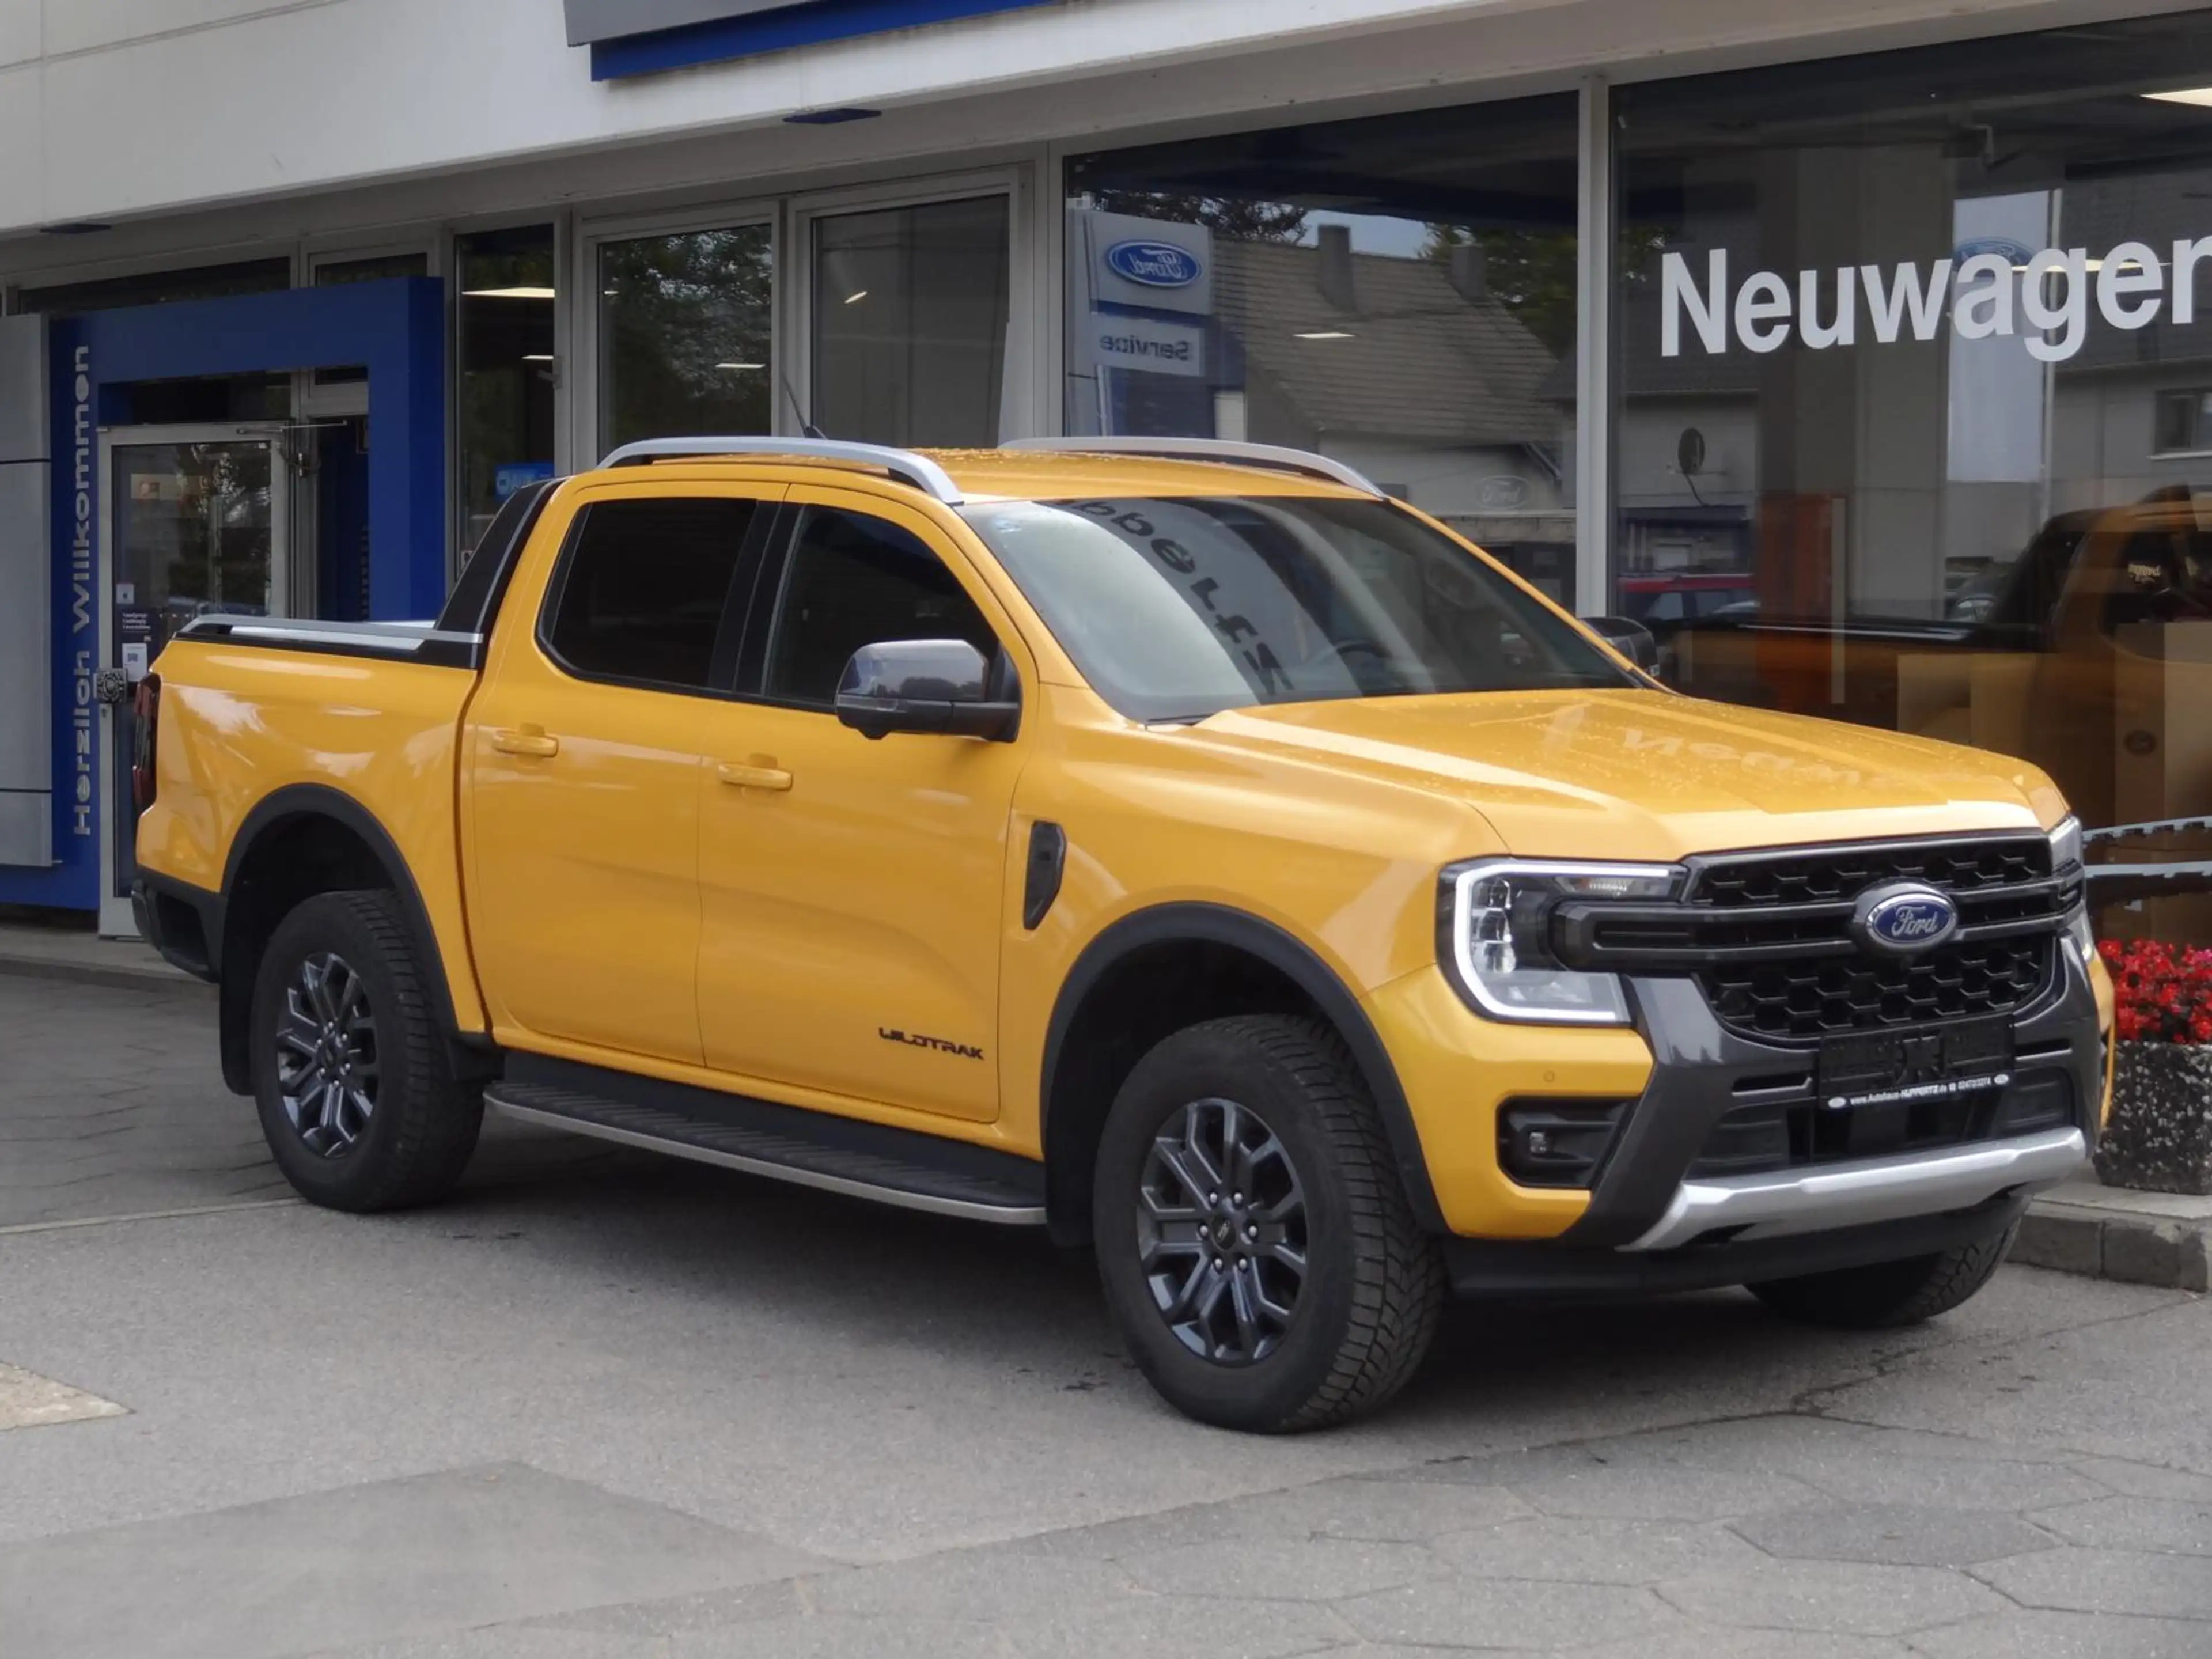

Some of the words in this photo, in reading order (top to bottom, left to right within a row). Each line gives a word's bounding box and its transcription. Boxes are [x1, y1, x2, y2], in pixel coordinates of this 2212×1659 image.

[73, 650, 91, 836] Herzlich
[1891, 905, 1939, 937] Ford
[878, 1027, 984, 1061] WILDTRAK
